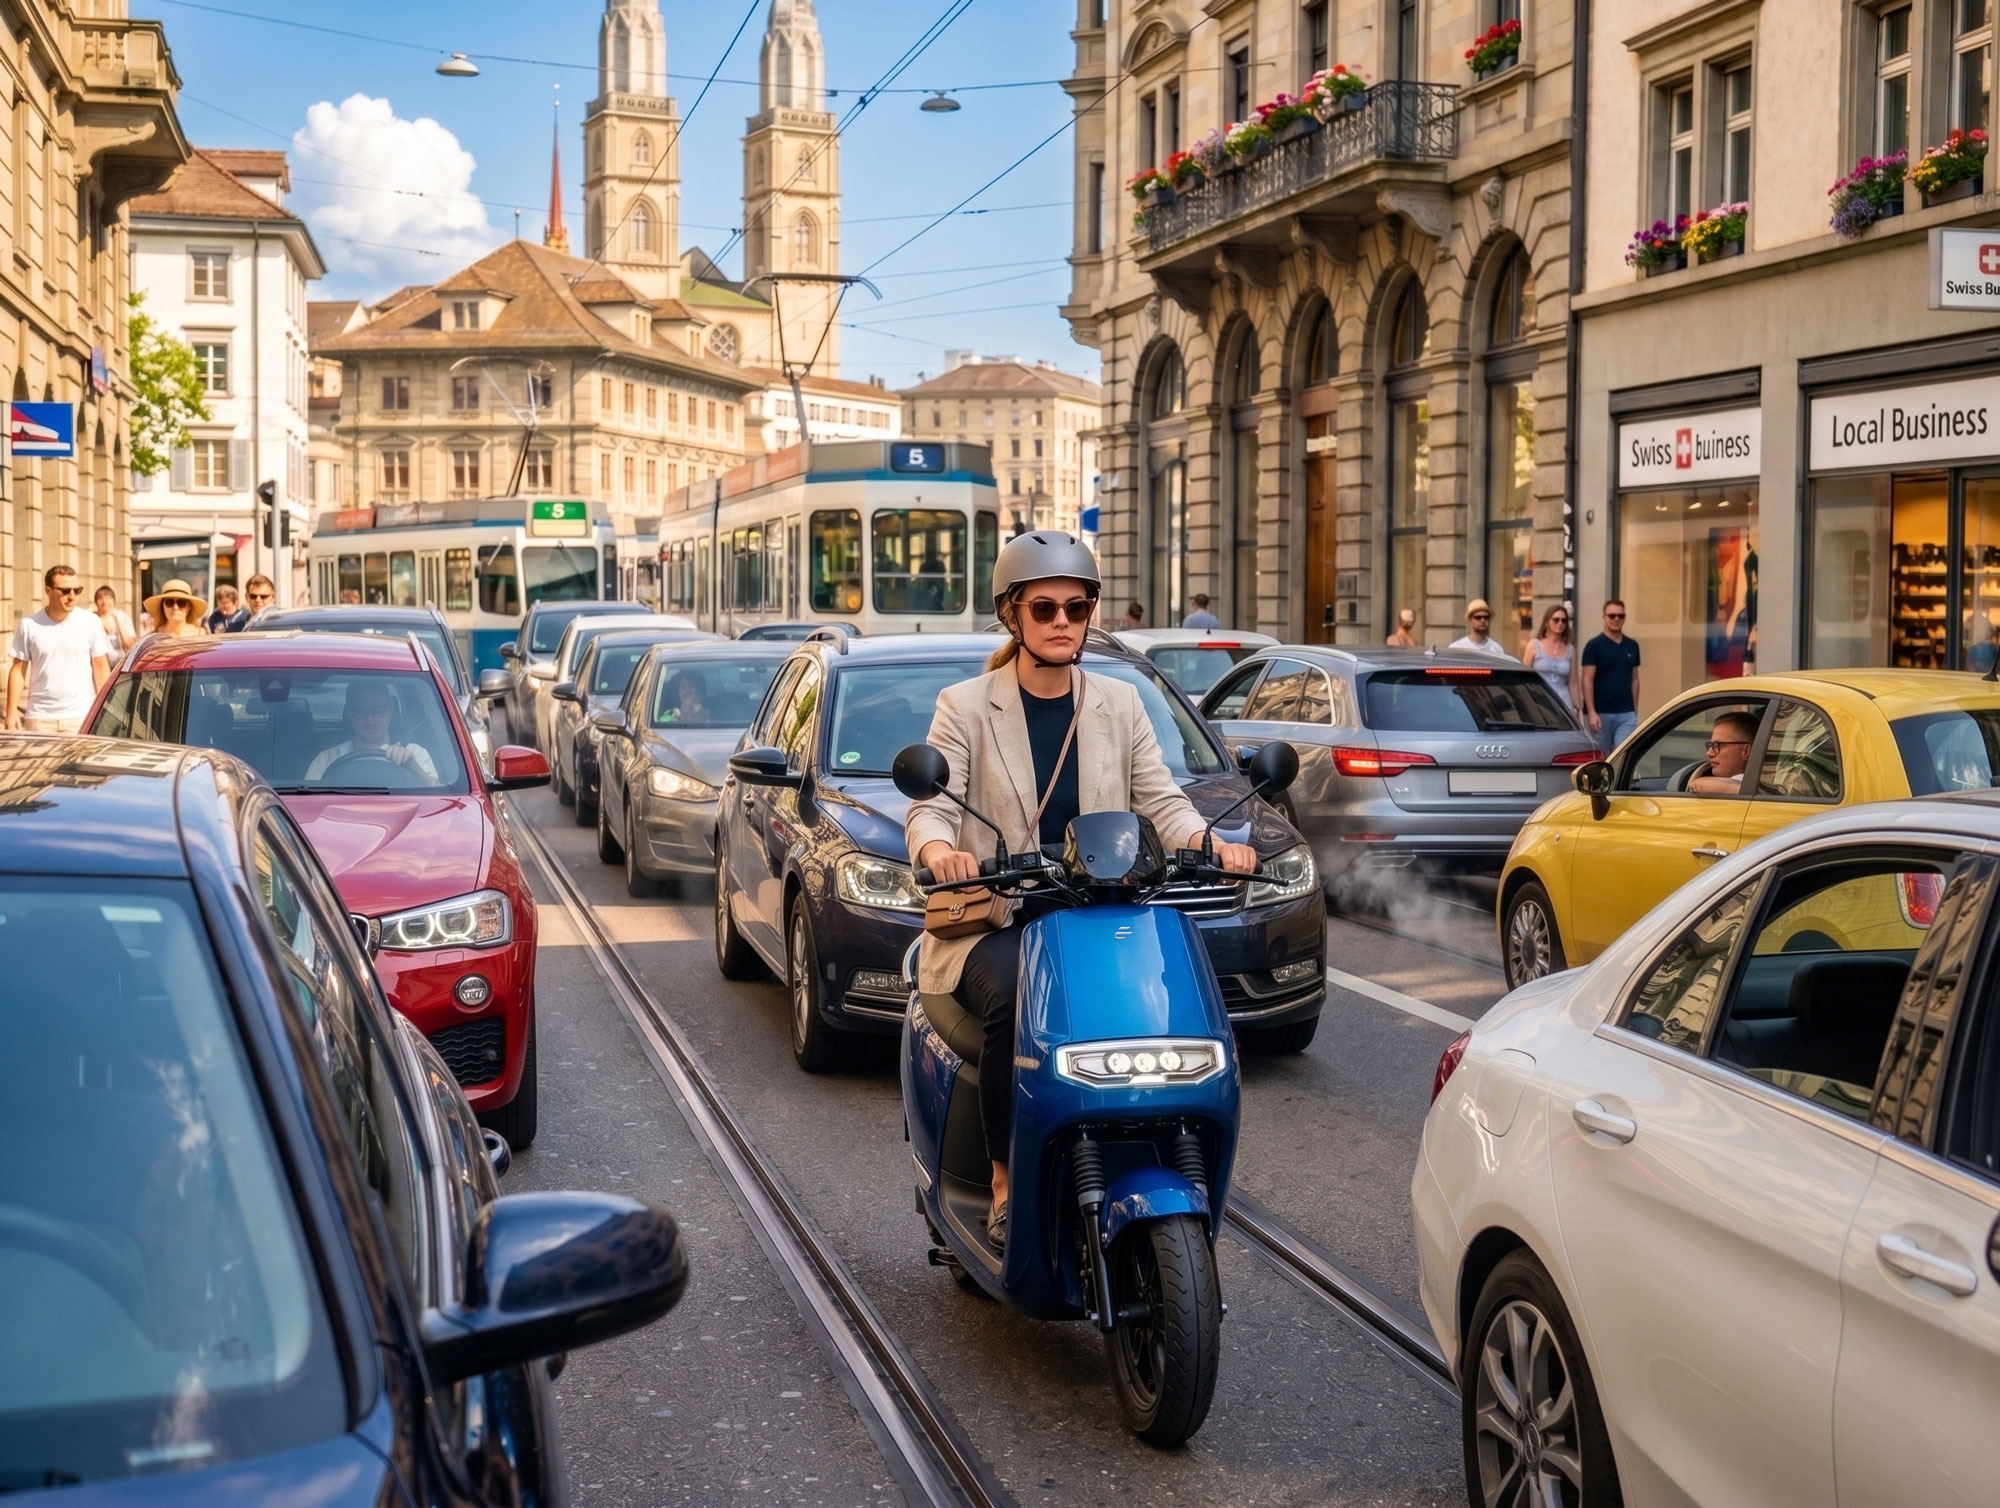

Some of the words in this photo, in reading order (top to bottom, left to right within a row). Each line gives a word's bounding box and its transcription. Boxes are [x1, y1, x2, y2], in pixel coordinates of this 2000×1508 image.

[1946, 280, 1983, 295] Swiss
[1832, 408, 1885, 447] Local
[1892, 403, 1988, 442] Business
[909, 448, 924, 465] 5
[1631, 438, 1672, 467] Swiss
[1695, 430, 1750, 461] buiness
